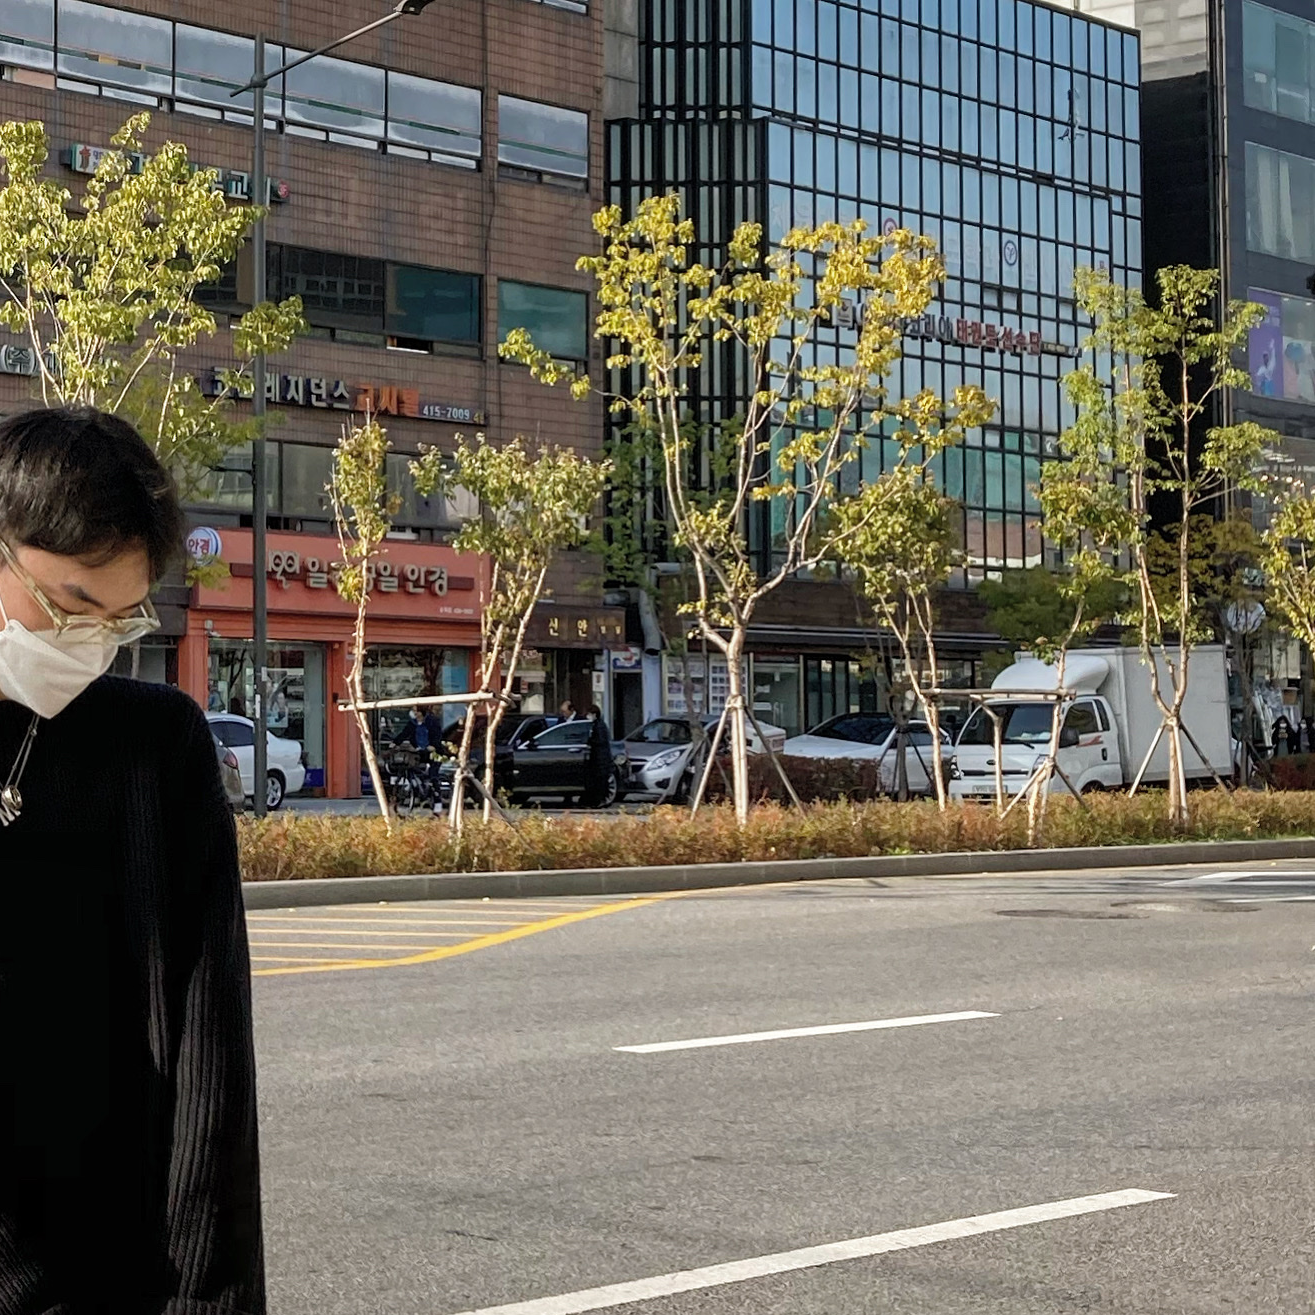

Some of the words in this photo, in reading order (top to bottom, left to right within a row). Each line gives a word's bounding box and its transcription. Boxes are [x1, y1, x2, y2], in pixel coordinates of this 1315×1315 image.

[212, 366, 350, 409] 레지던스
[421, 404, 471, 421] 415-7009
[188, 538, 210, 555] 안경
[405, 563, 448, 597] 안경
